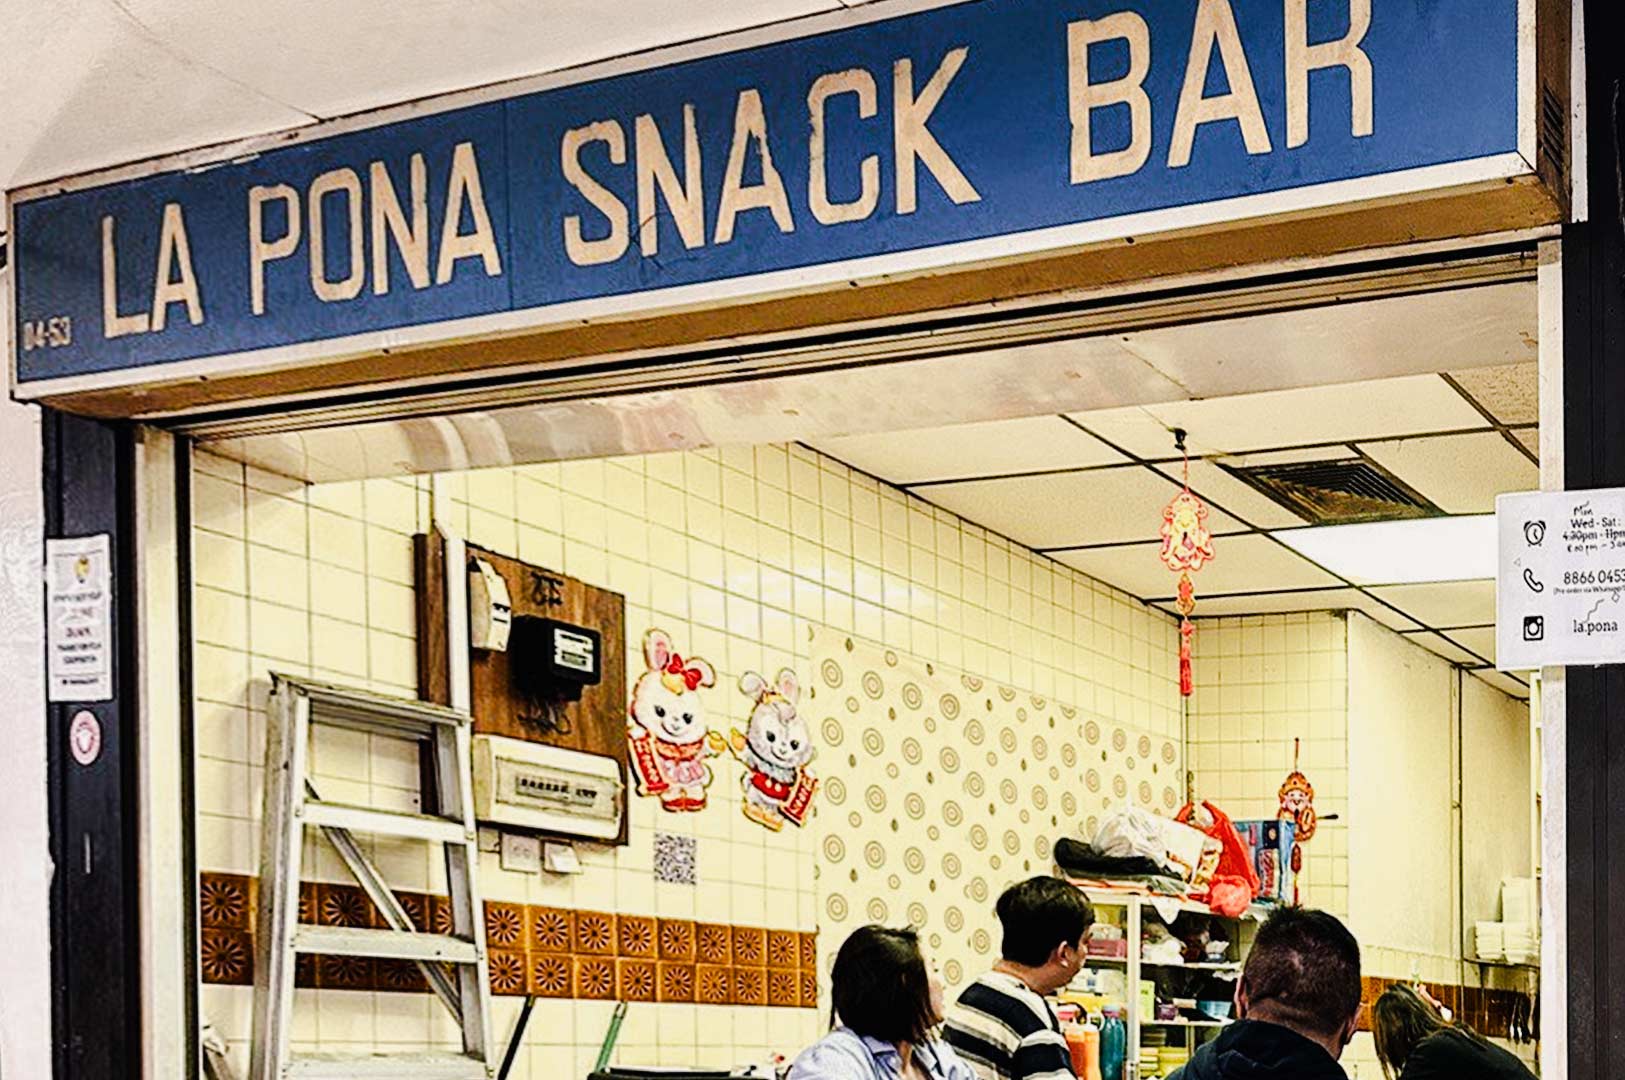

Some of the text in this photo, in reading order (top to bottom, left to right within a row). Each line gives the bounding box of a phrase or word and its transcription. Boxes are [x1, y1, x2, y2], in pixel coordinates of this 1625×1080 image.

[103, 0, 1374, 339] LA PONA SNACK BAR
[23, 316, 71, 350] 04-53
[1570, 518, 1594, 528] Wed
[1563, 568, 1625, 584] 8866 0453
[1573, 618, 1618, 636] la.pona
